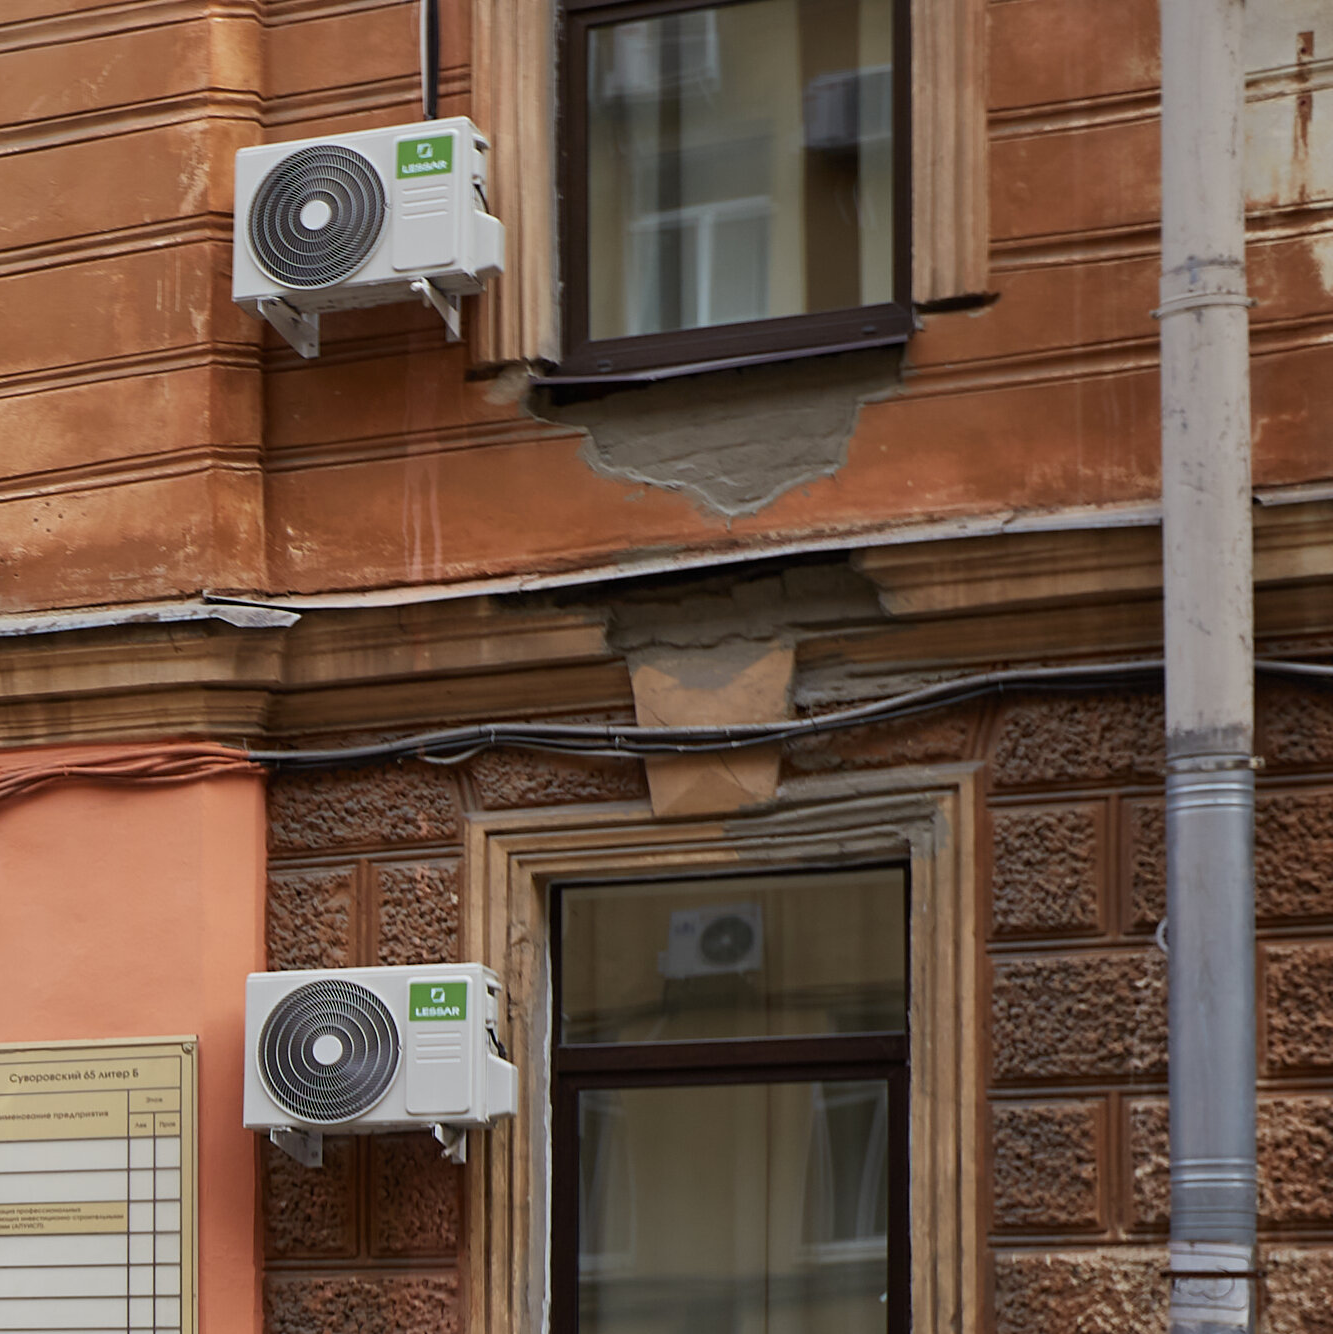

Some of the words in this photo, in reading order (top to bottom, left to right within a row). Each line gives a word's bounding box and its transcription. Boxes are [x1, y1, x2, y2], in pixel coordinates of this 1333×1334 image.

[402, 160, 447, 173] LESSAR
[415, 1006, 460, 1017] LESSAR
[9, 1070, 81, 1084] Суворовский
[83, 1071, 96, 1080] 65
[98, 1071, 130, 1081] литер
[132, 1069, 139, 1078] Б
[52, 1110, 109, 1120] предприятия
